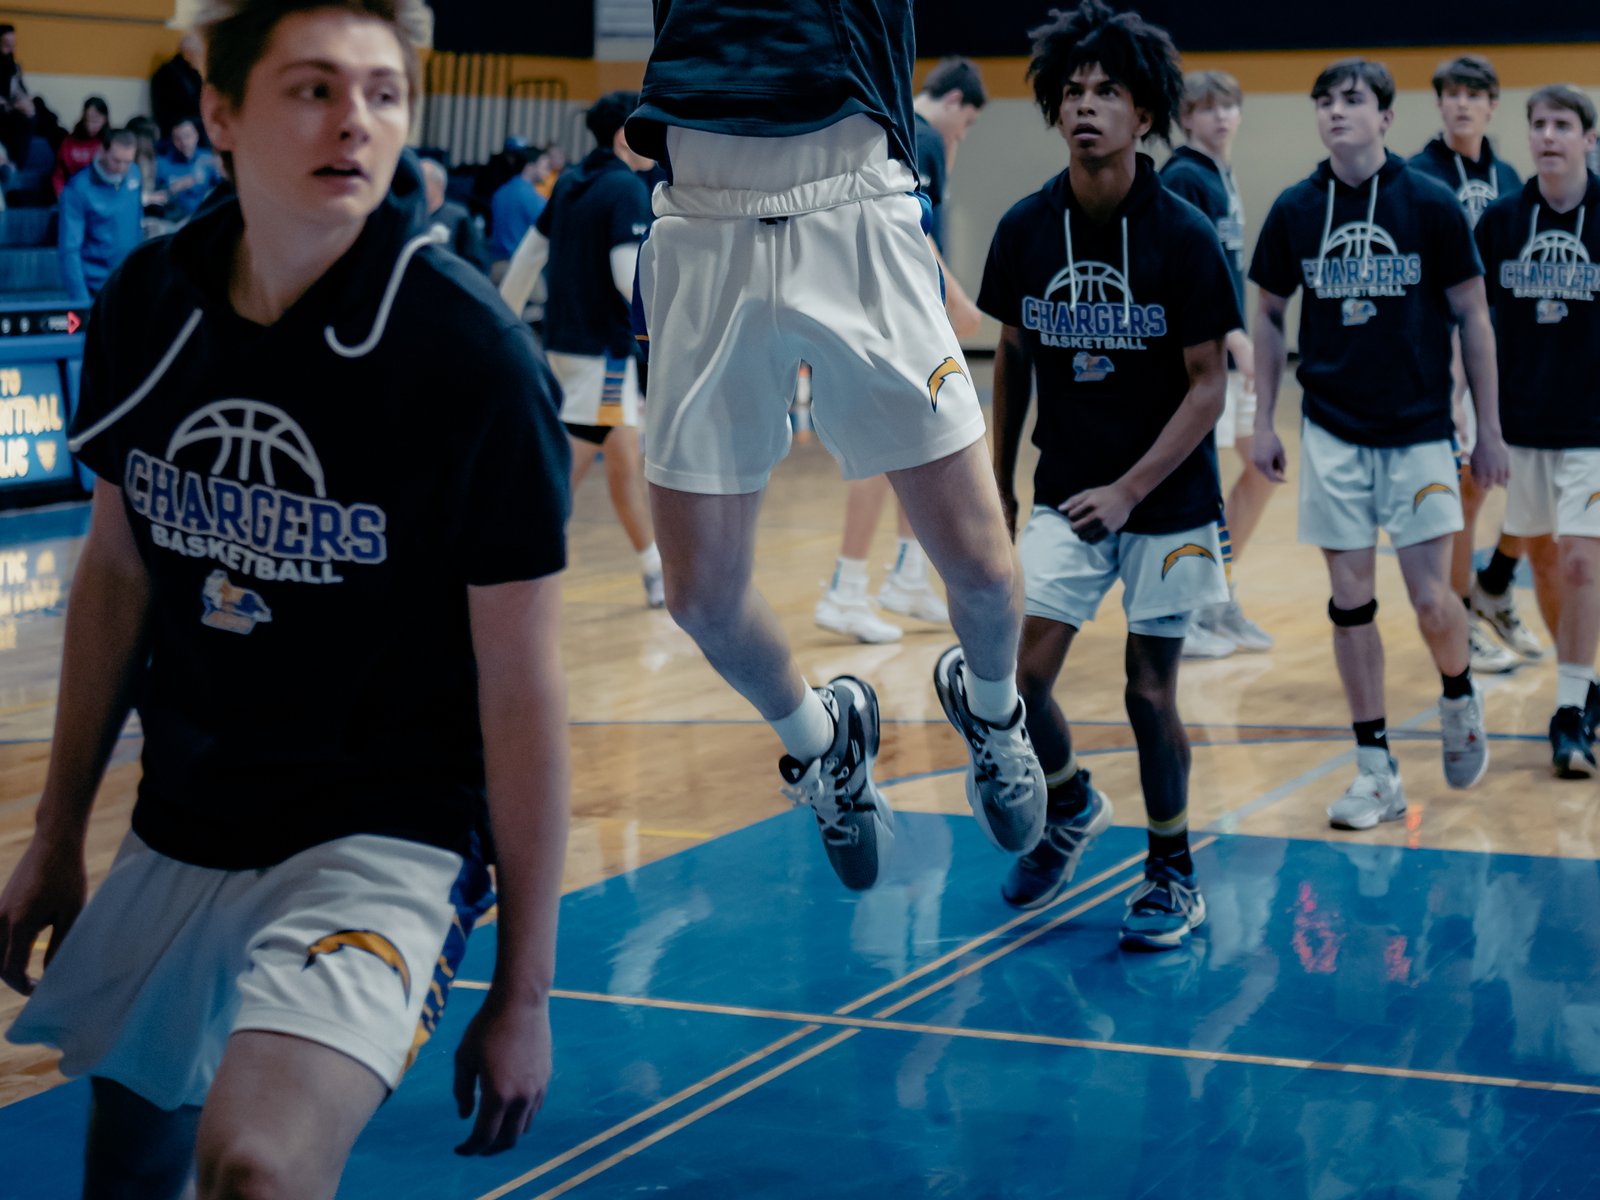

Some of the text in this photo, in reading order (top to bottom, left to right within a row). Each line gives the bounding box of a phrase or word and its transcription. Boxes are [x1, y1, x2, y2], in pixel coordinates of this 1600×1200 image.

[1022, 296, 1168, 338] CHARGERS
[1040, 332, 1147, 350] BASKETBALL
[124, 448, 387, 565] CHARGERS
[151, 523, 344, 584] BASKETBALL
